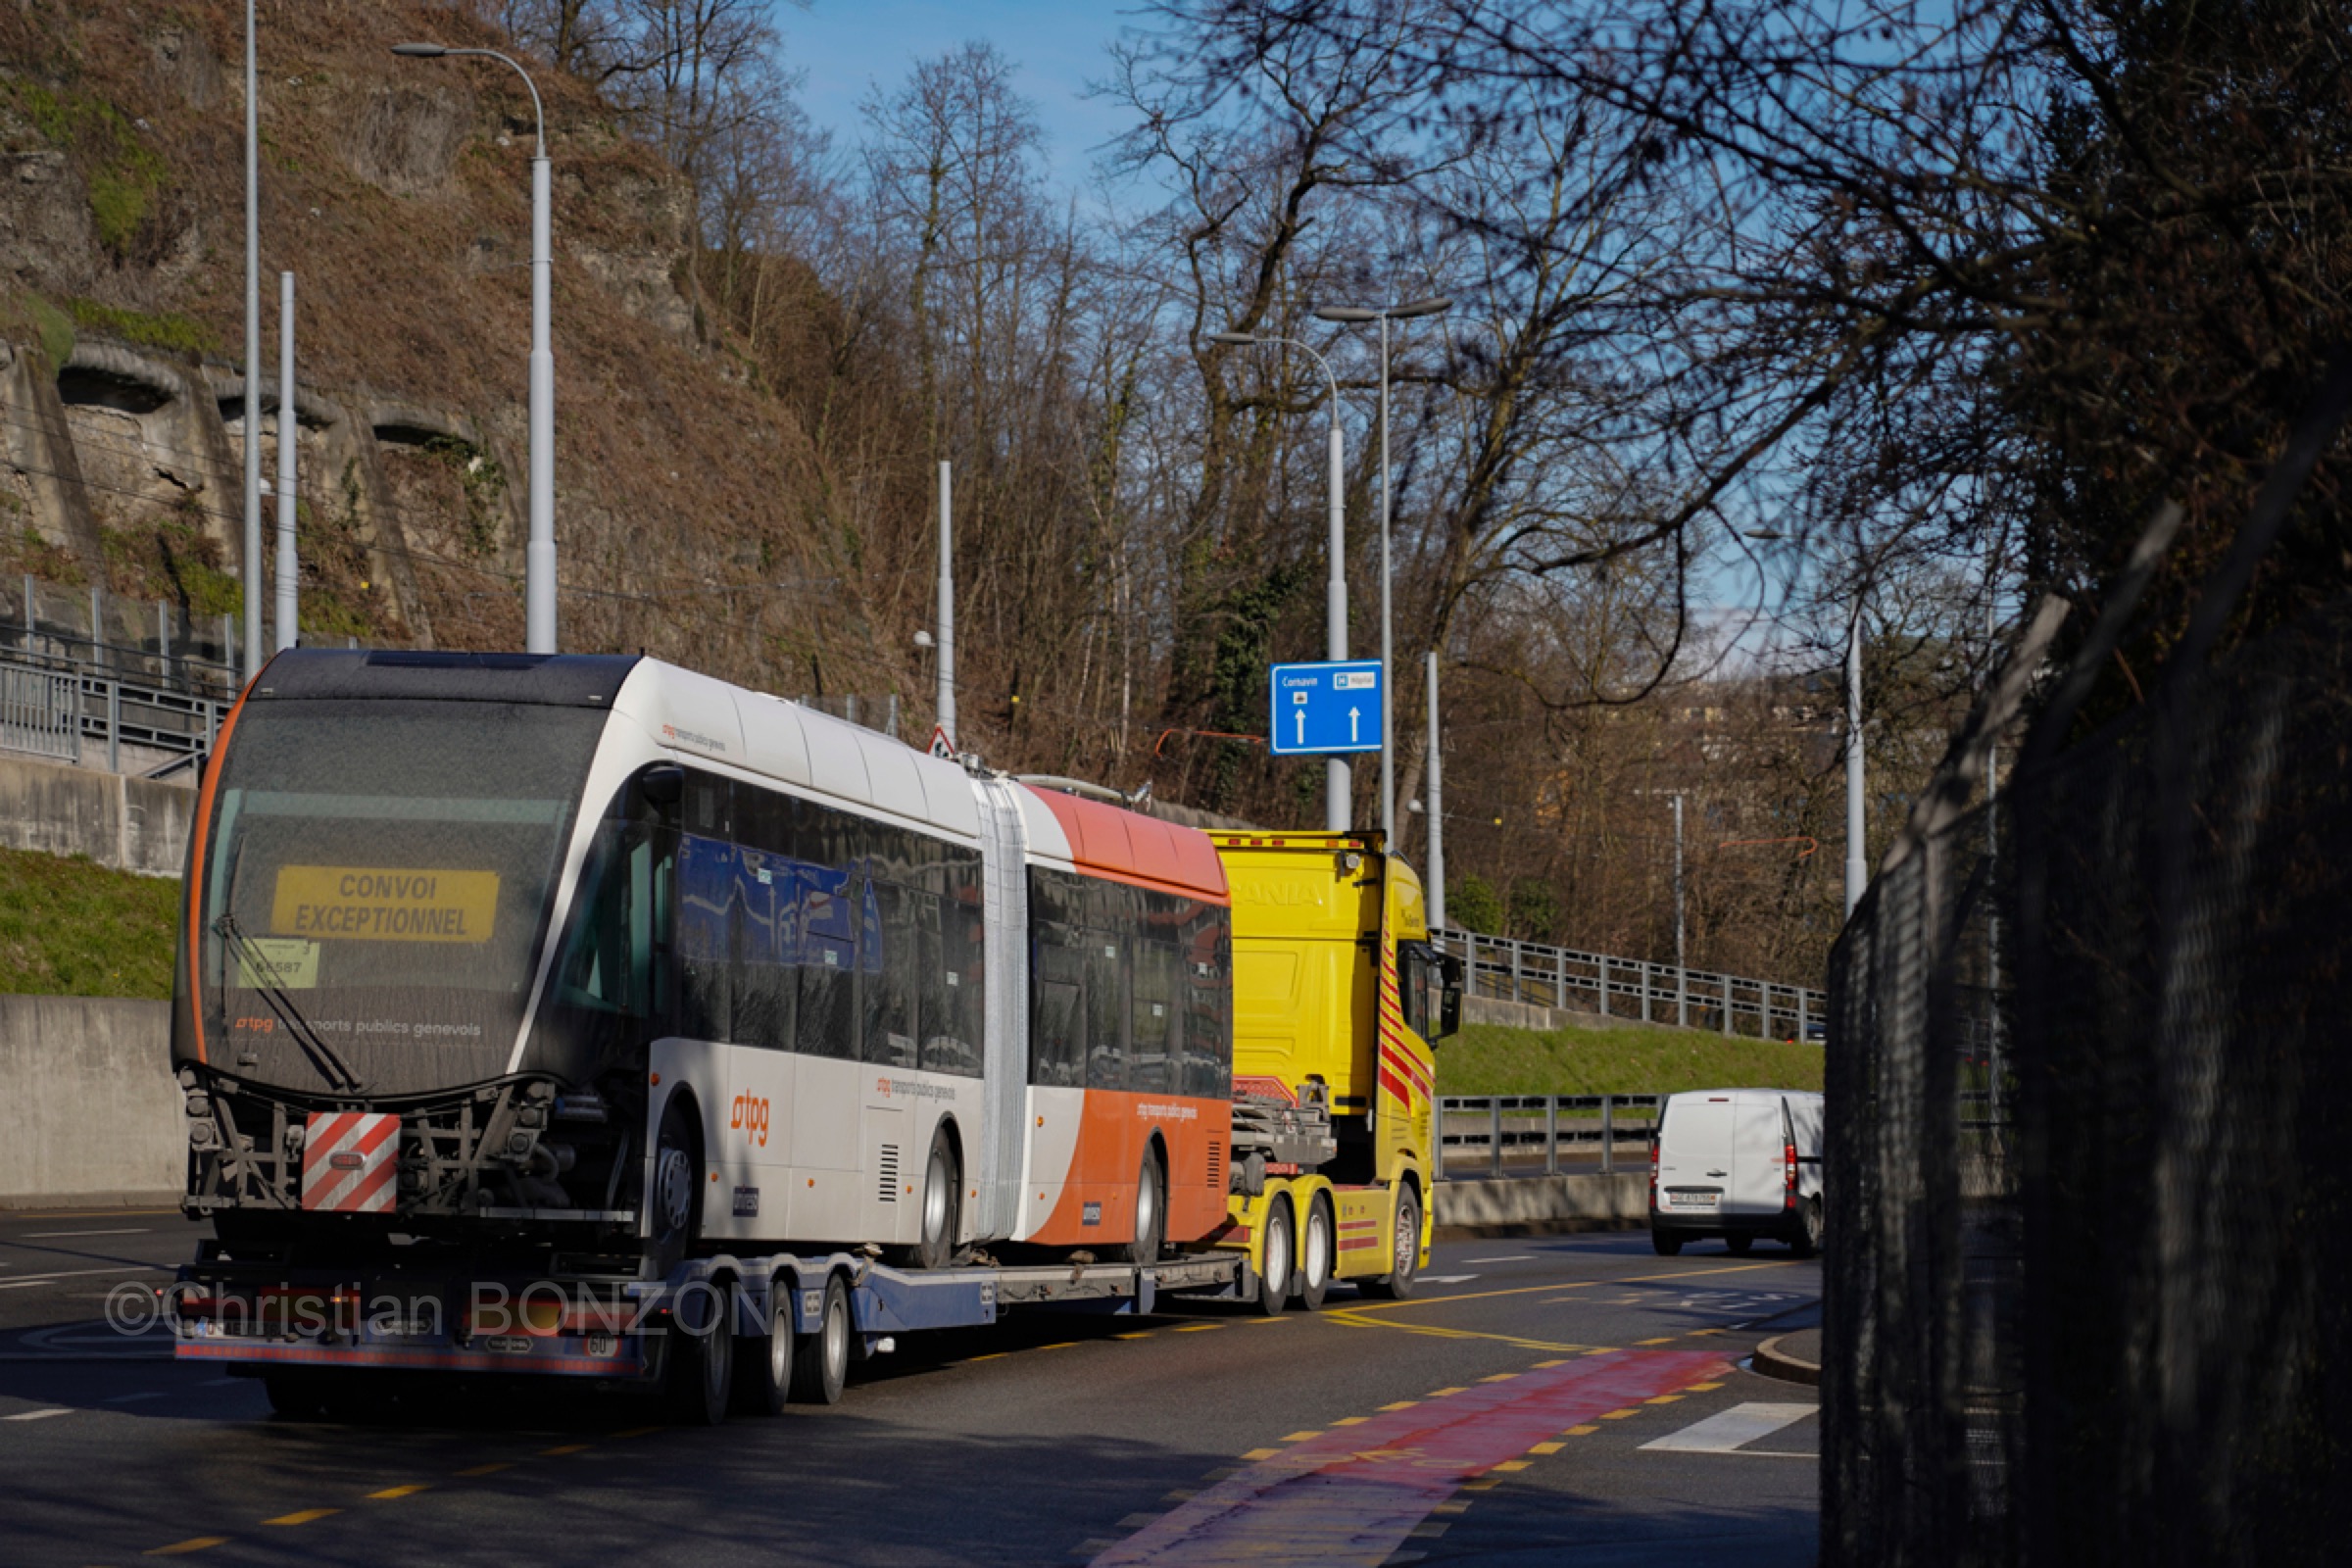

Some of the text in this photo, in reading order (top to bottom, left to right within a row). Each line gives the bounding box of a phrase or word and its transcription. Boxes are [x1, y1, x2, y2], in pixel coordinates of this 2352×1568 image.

[339, 873, 437, 902] CONVOI
[295, 905, 467, 936] EXCEPTIONNEL
[356, 1018, 409, 1036] publics
[414, 1022, 481, 1039] genevois
[589, 1335, 606, 1354] 60
